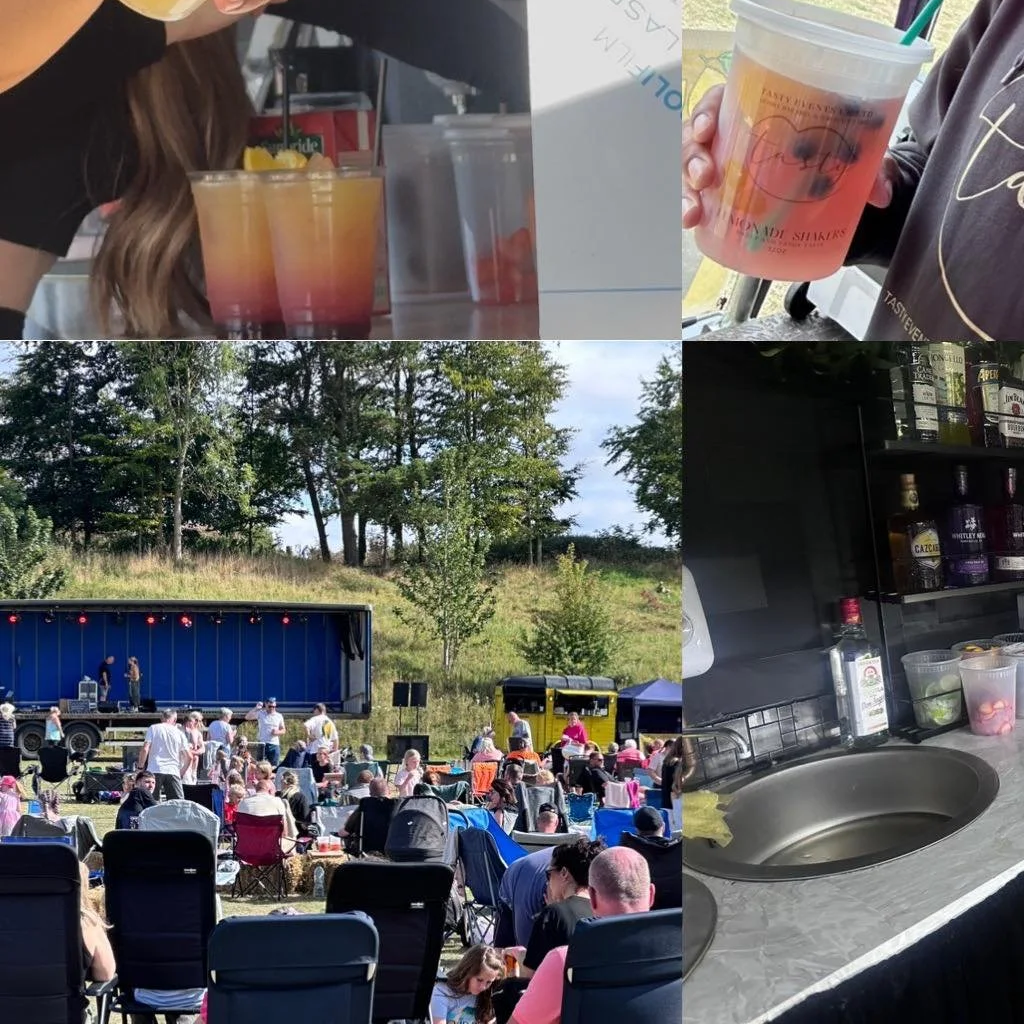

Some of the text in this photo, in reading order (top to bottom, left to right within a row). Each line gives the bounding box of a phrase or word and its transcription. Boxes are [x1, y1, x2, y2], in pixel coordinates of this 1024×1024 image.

[761, 87, 790, 104] TASTY
[792, 228, 846, 242] SHAKERS
[1007, 422, 1024, 432] BOURBON
[951, 532, 976, 540] WHITLEY
